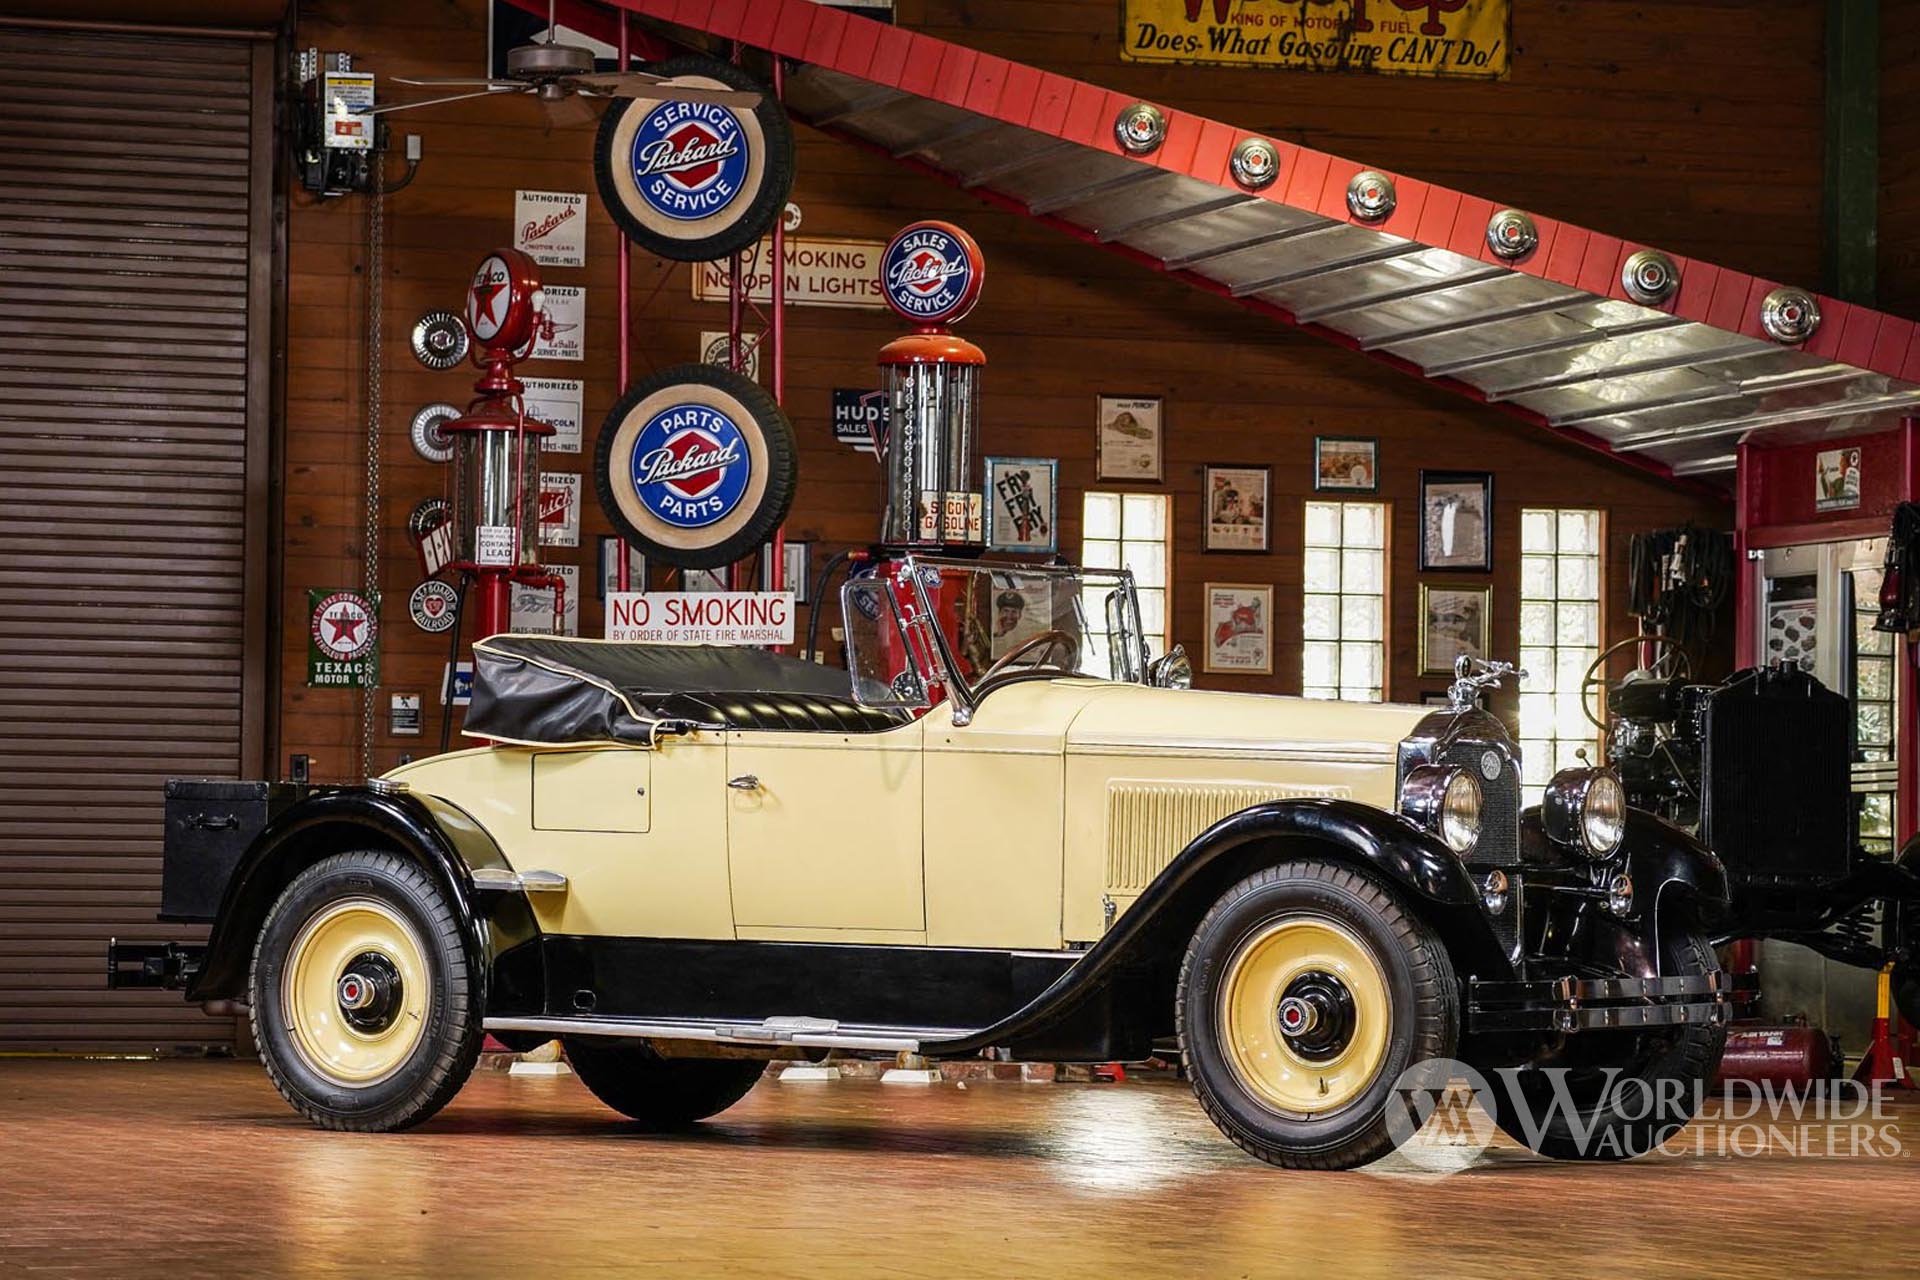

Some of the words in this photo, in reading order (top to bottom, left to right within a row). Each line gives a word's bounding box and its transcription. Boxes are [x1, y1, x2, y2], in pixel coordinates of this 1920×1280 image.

[1231, 13, 1264, 26] KING
[1270, 15, 1287, 27] OF
[1380, 21, 1415, 34] FUEL
[1134, 22, 1199, 54] Does
[1208, 27, 1272, 55] What
[1279, 31, 1383, 64] Gasoline
[1388, 37, 1454, 65] CAN'T
[1456, 40, 1501, 67] Do!
[653, 103, 734, 133] SERVICE
[637, 130, 739, 176] Packard
[522, 192, 581, 204] AUTHORIZED
[651, 179, 733, 211] SERVICE
[520, 205, 576, 244] Packard
[903, 233, 948, 253] SALES
[889, 254, 965, 290] Packard
[744, 279, 799, 292] OPN
[809, 278, 881, 296] LIGHTS
[898, 288, 955, 312] SERVICE
[523, 381, 578, 391] UTHORIZED
[660, 411, 724, 434] PARTS
[836, 405, 890, 421] HUDS
[836, 423, 868, 434] SALES
[637, 437, 740, 485] Packard
[539, 486, 574, 519] uick
[659, 495, 724, 519] PARTS
[486, 549, 512, 557] LEAD
[613, 598, 650, 626] NO
[664, 598, 786, 627] SMOKING
[613, 630, 626, 640] BY
[630, 630, 663, 640] ORDER
[667, 630, 679, 640] OF
[683, 630, 712, 640] STATE
[715, 630, 736, 640] FIRE
[740, 630, 785, 641] MARSHAL
[315, 674, 350, 684] MOTOR
